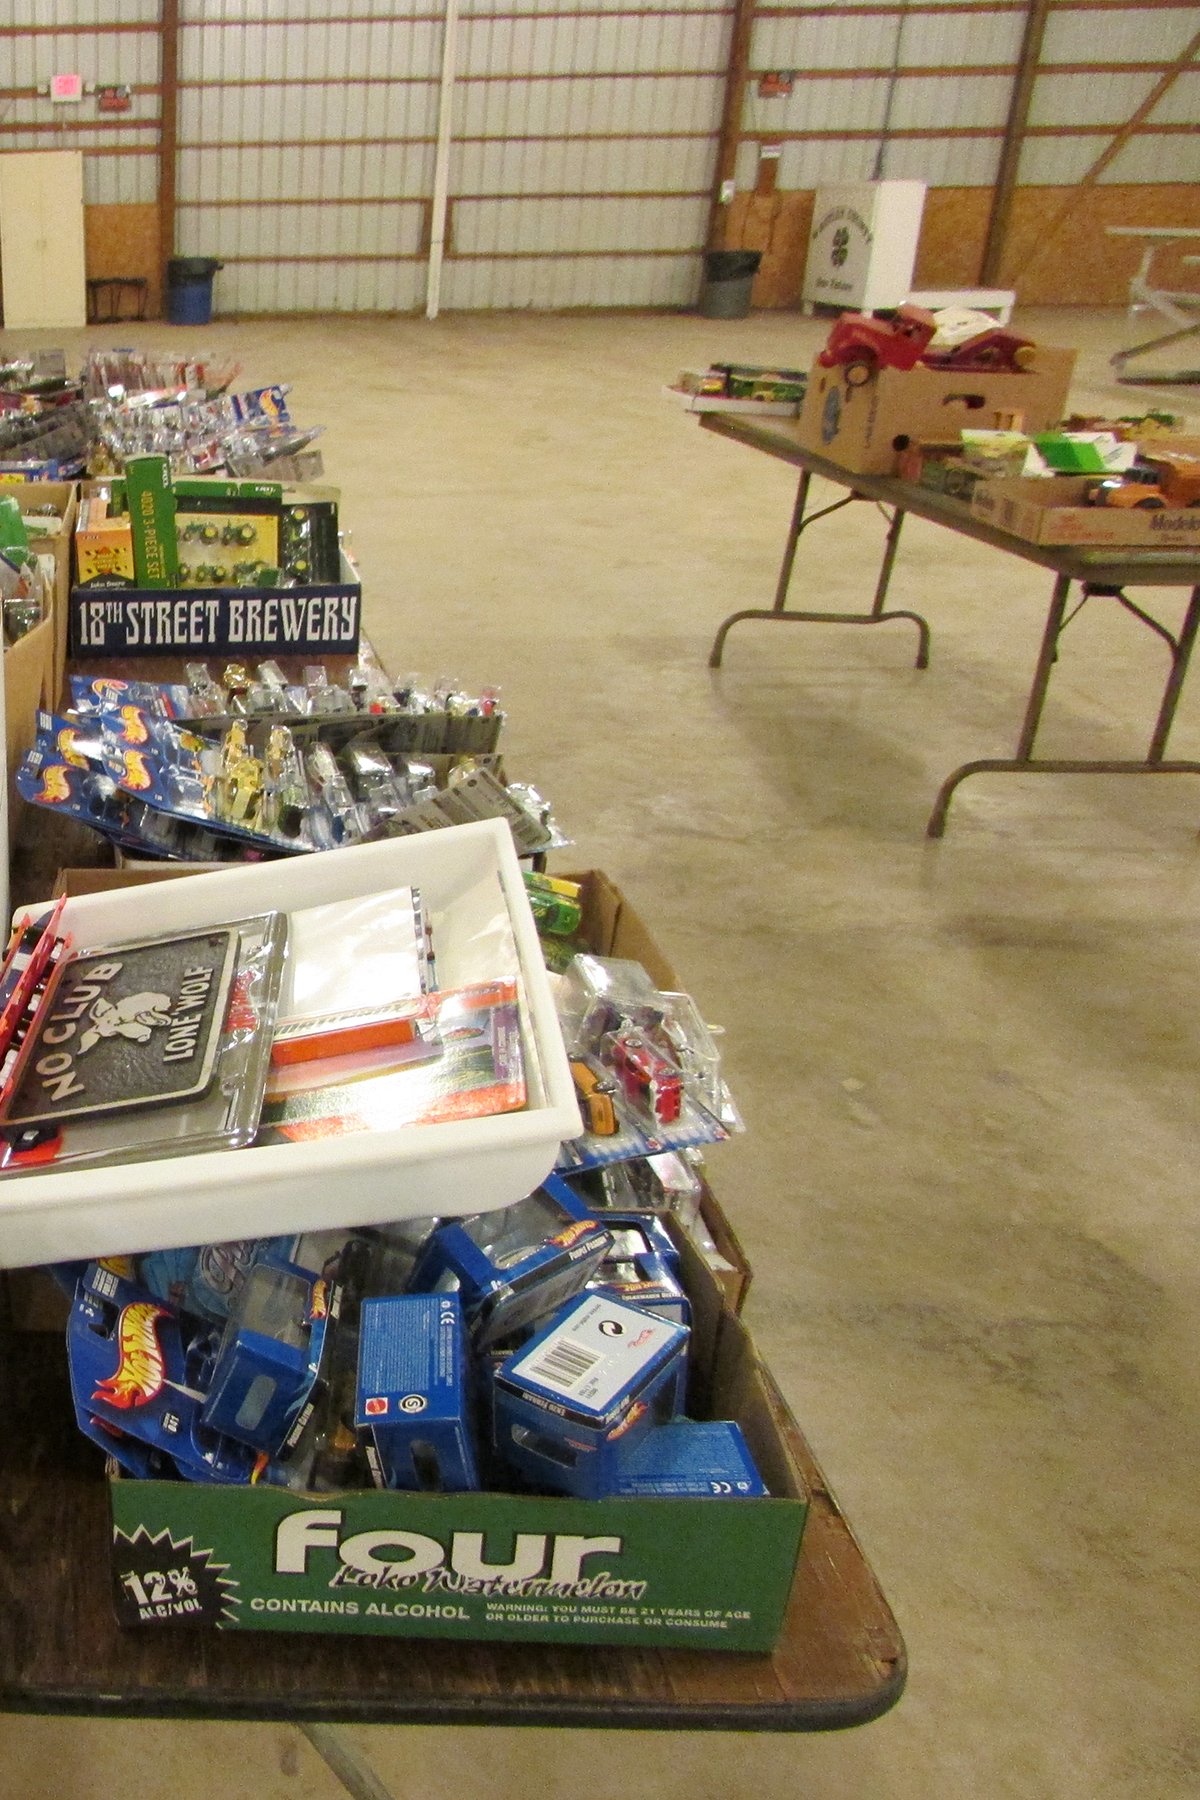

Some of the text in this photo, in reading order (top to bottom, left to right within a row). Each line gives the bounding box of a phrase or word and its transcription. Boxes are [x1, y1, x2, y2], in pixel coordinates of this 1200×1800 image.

[126, 600, 220, 645] STREET
[228, 596, 357, 642] BREWERY
[162, 965, 215, 1063] LONE WOLF
[36, 962, 123, 1102] NO CLUB
[119, 1566, 199, 1605] 12%
[138, 1599, 203, 1620] ALC/VOL
[249, 1598, 472, 1620] CONTAINS ALCOHOL
[485, 1612, 729, 1629] OR OLDER TO PURCHASE OR CONSUME
[552, 1604, 578, 1614] YOU
[580, 1605, 617, 1616] MUST
[620, 1607, 637, 1616] BE
[640, 1607, 656, 1616] 21
[660, 1608, 701, 1618] YEARS
[704, 1610, 722, 1619] OF
[724, 1610, 751, 1620] AGE
